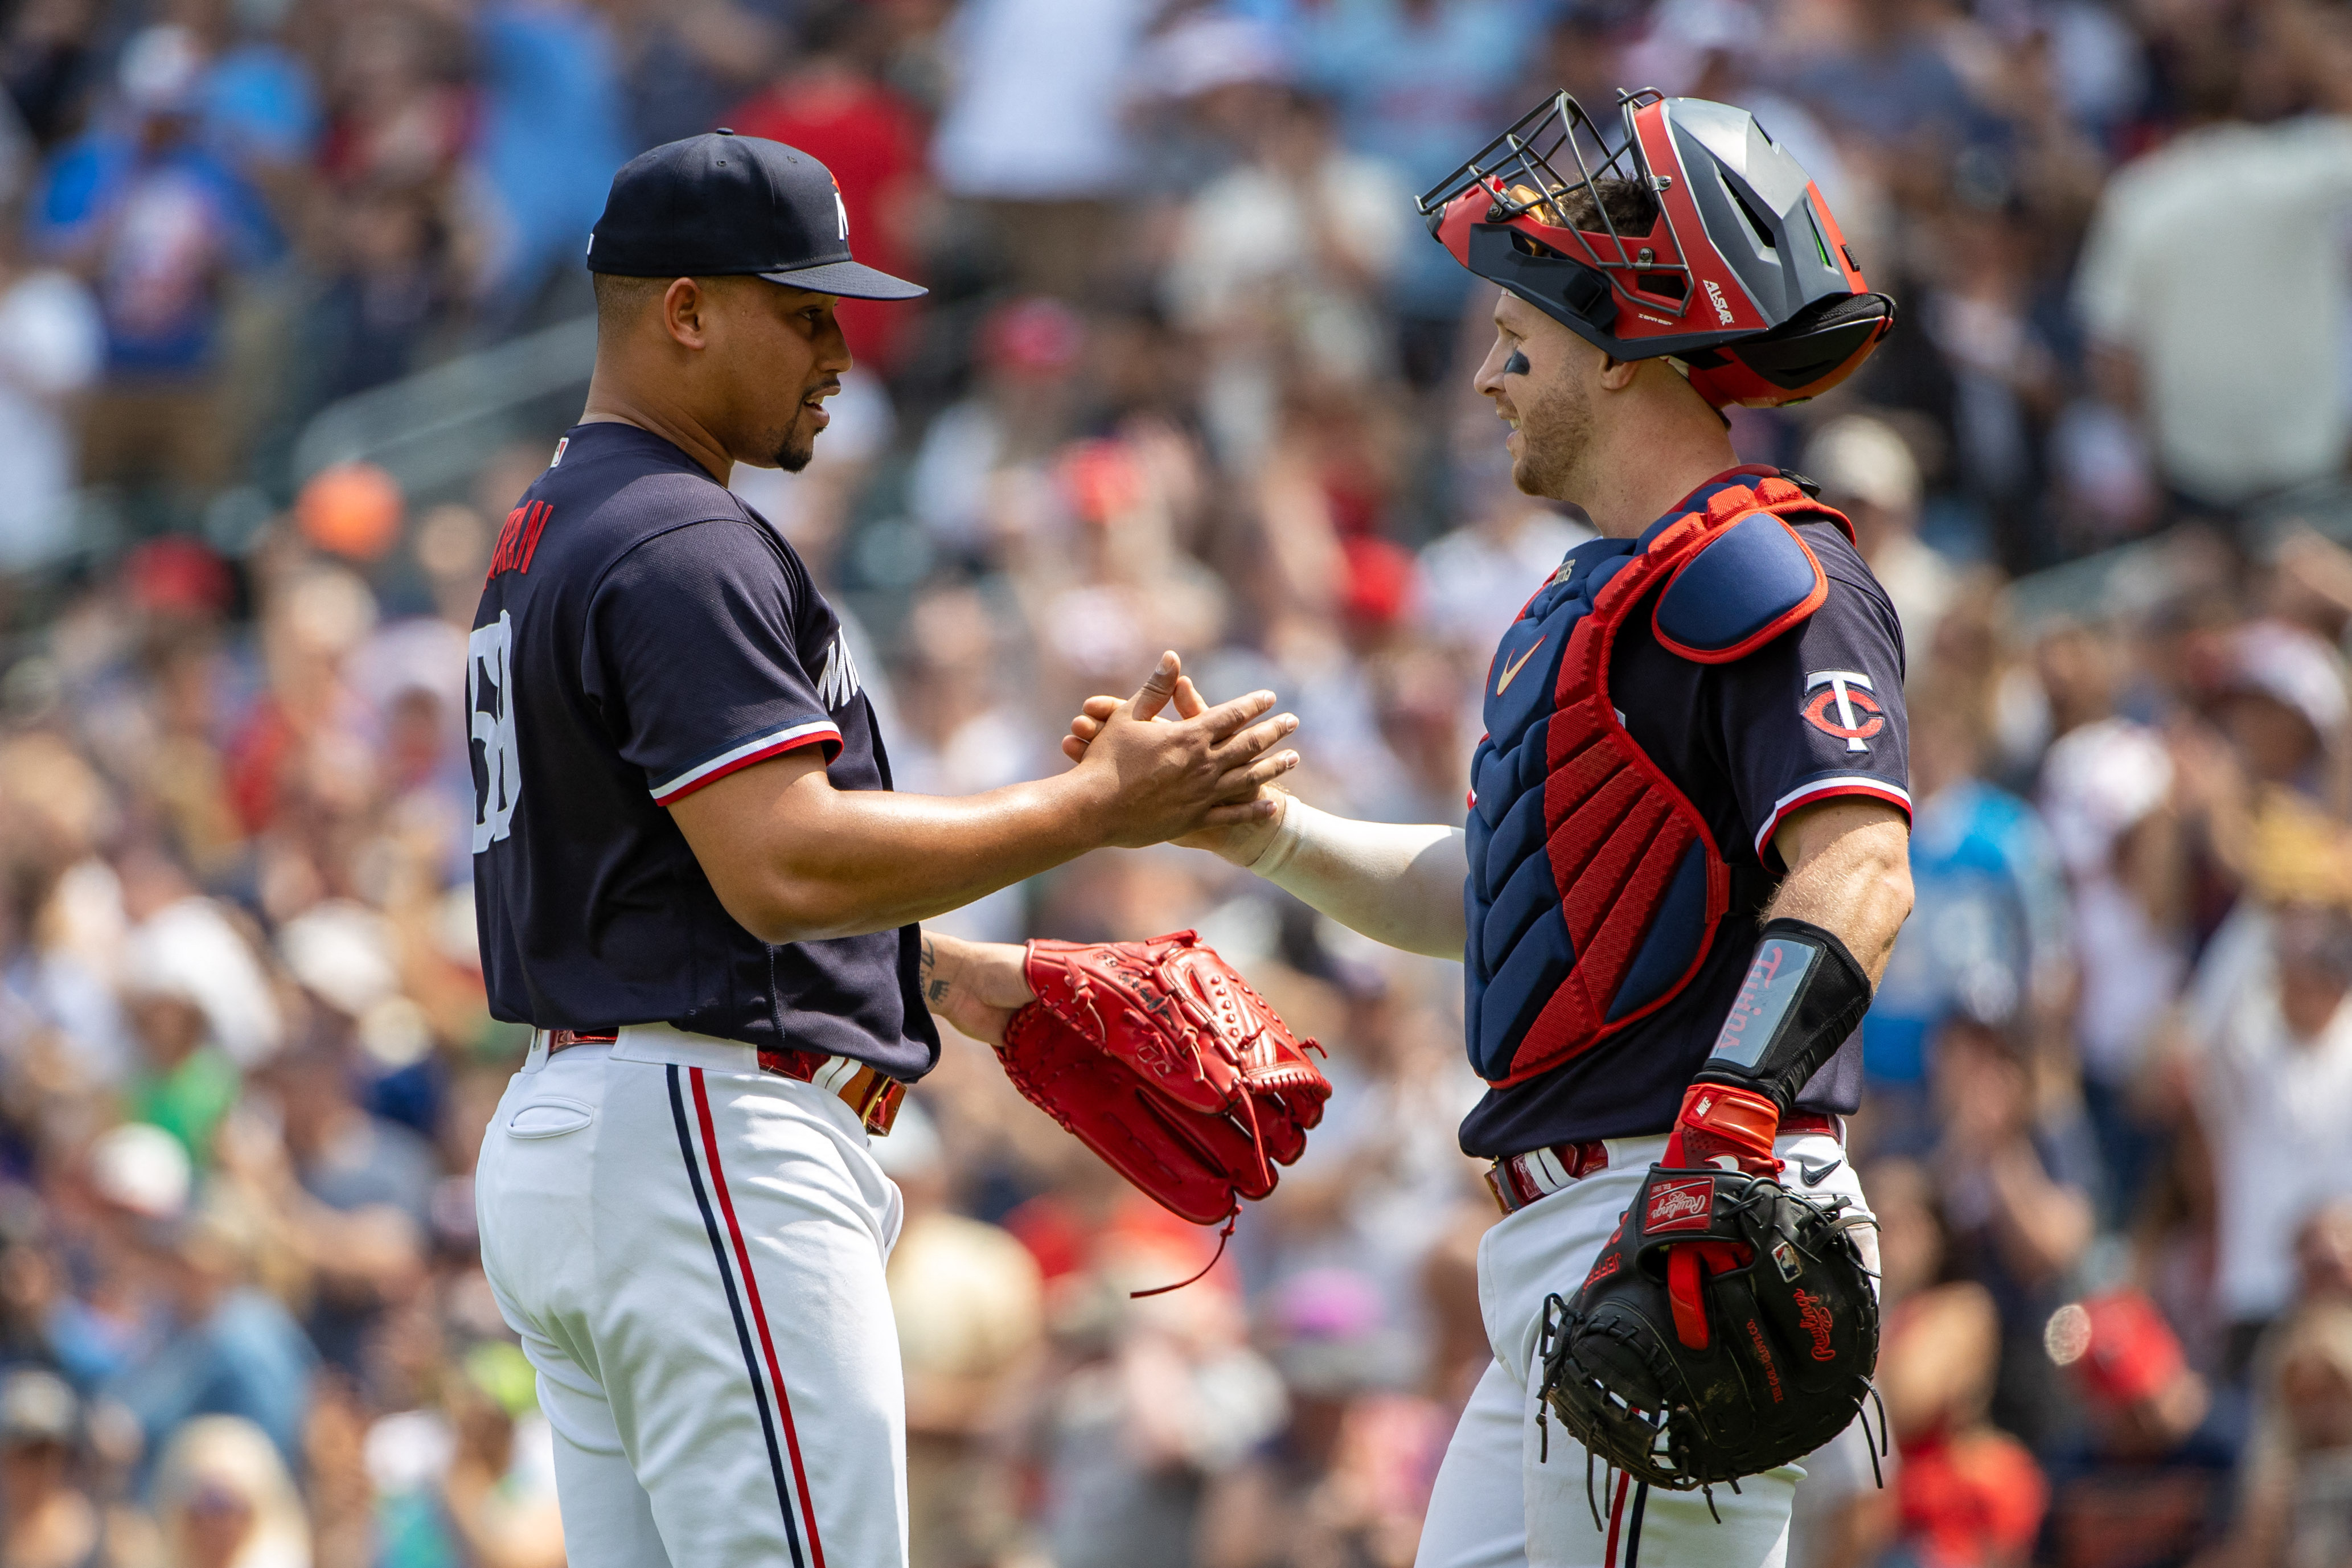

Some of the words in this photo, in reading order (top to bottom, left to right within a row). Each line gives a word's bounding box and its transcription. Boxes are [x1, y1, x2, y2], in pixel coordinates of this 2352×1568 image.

[1702, 279, 1735, 326] ALL-STAR
[1696, 1096, 1712, 1117] NIKE
[1651, 1192, 1706, 1219] Rawlings
[1746, 1318, 1758, 1335] CO.
[1793, 1288, 1836, 1362] Rawlings
